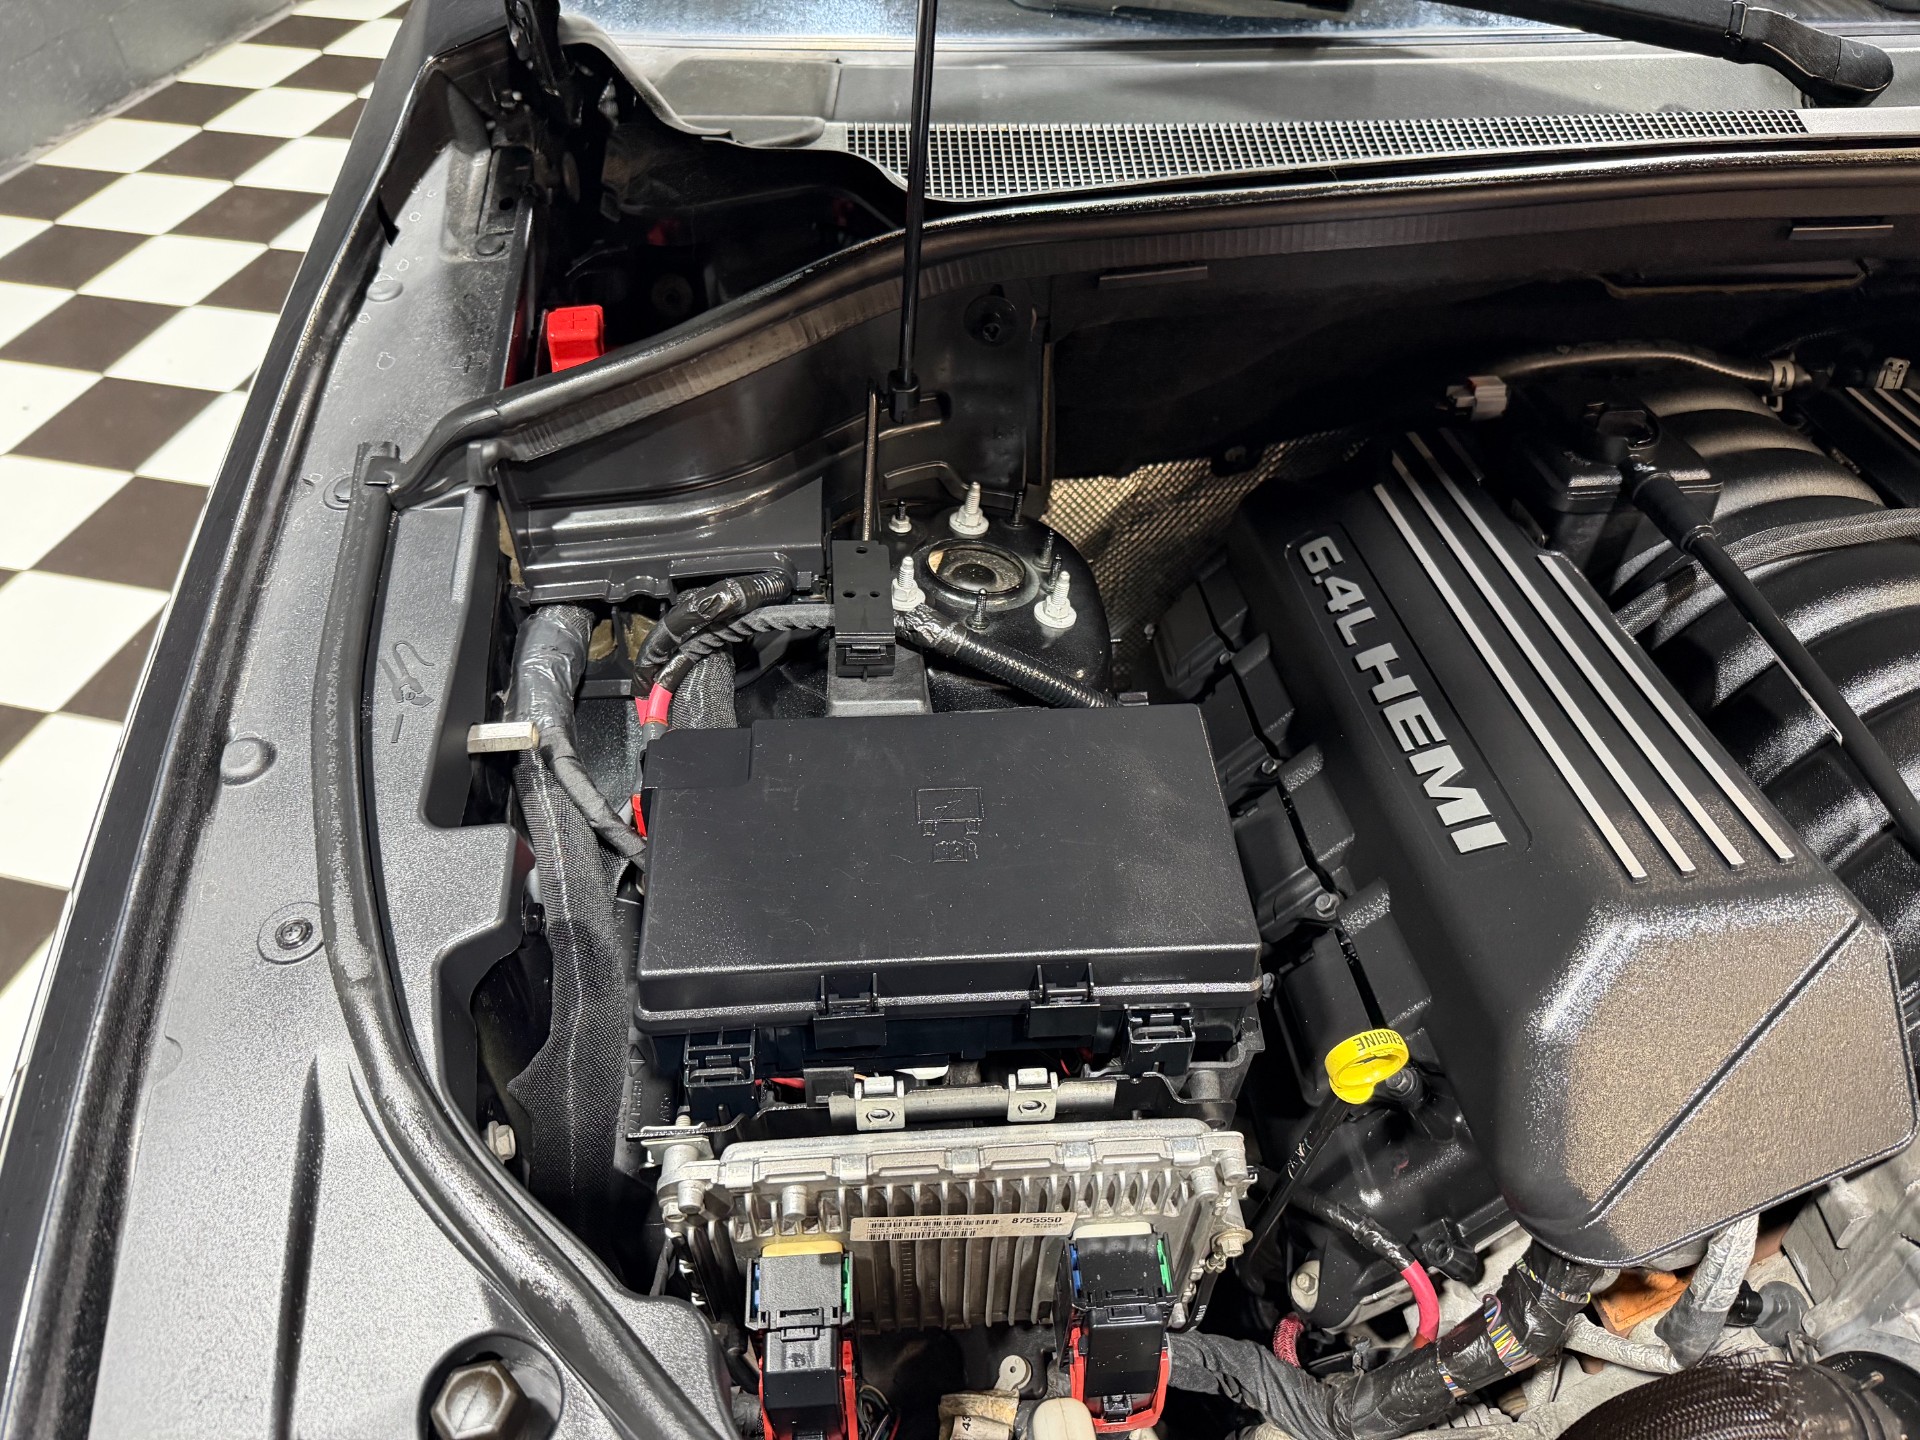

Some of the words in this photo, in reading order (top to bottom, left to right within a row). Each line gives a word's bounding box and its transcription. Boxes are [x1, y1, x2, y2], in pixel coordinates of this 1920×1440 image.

[1300, 536, 1376, 646] 6.4L
[1354, 642, 1508, 854] HEMI
[1353, 1031, 1403, 1051] ENGINE
[1011, 1216, 1062, 1224] 8755550
